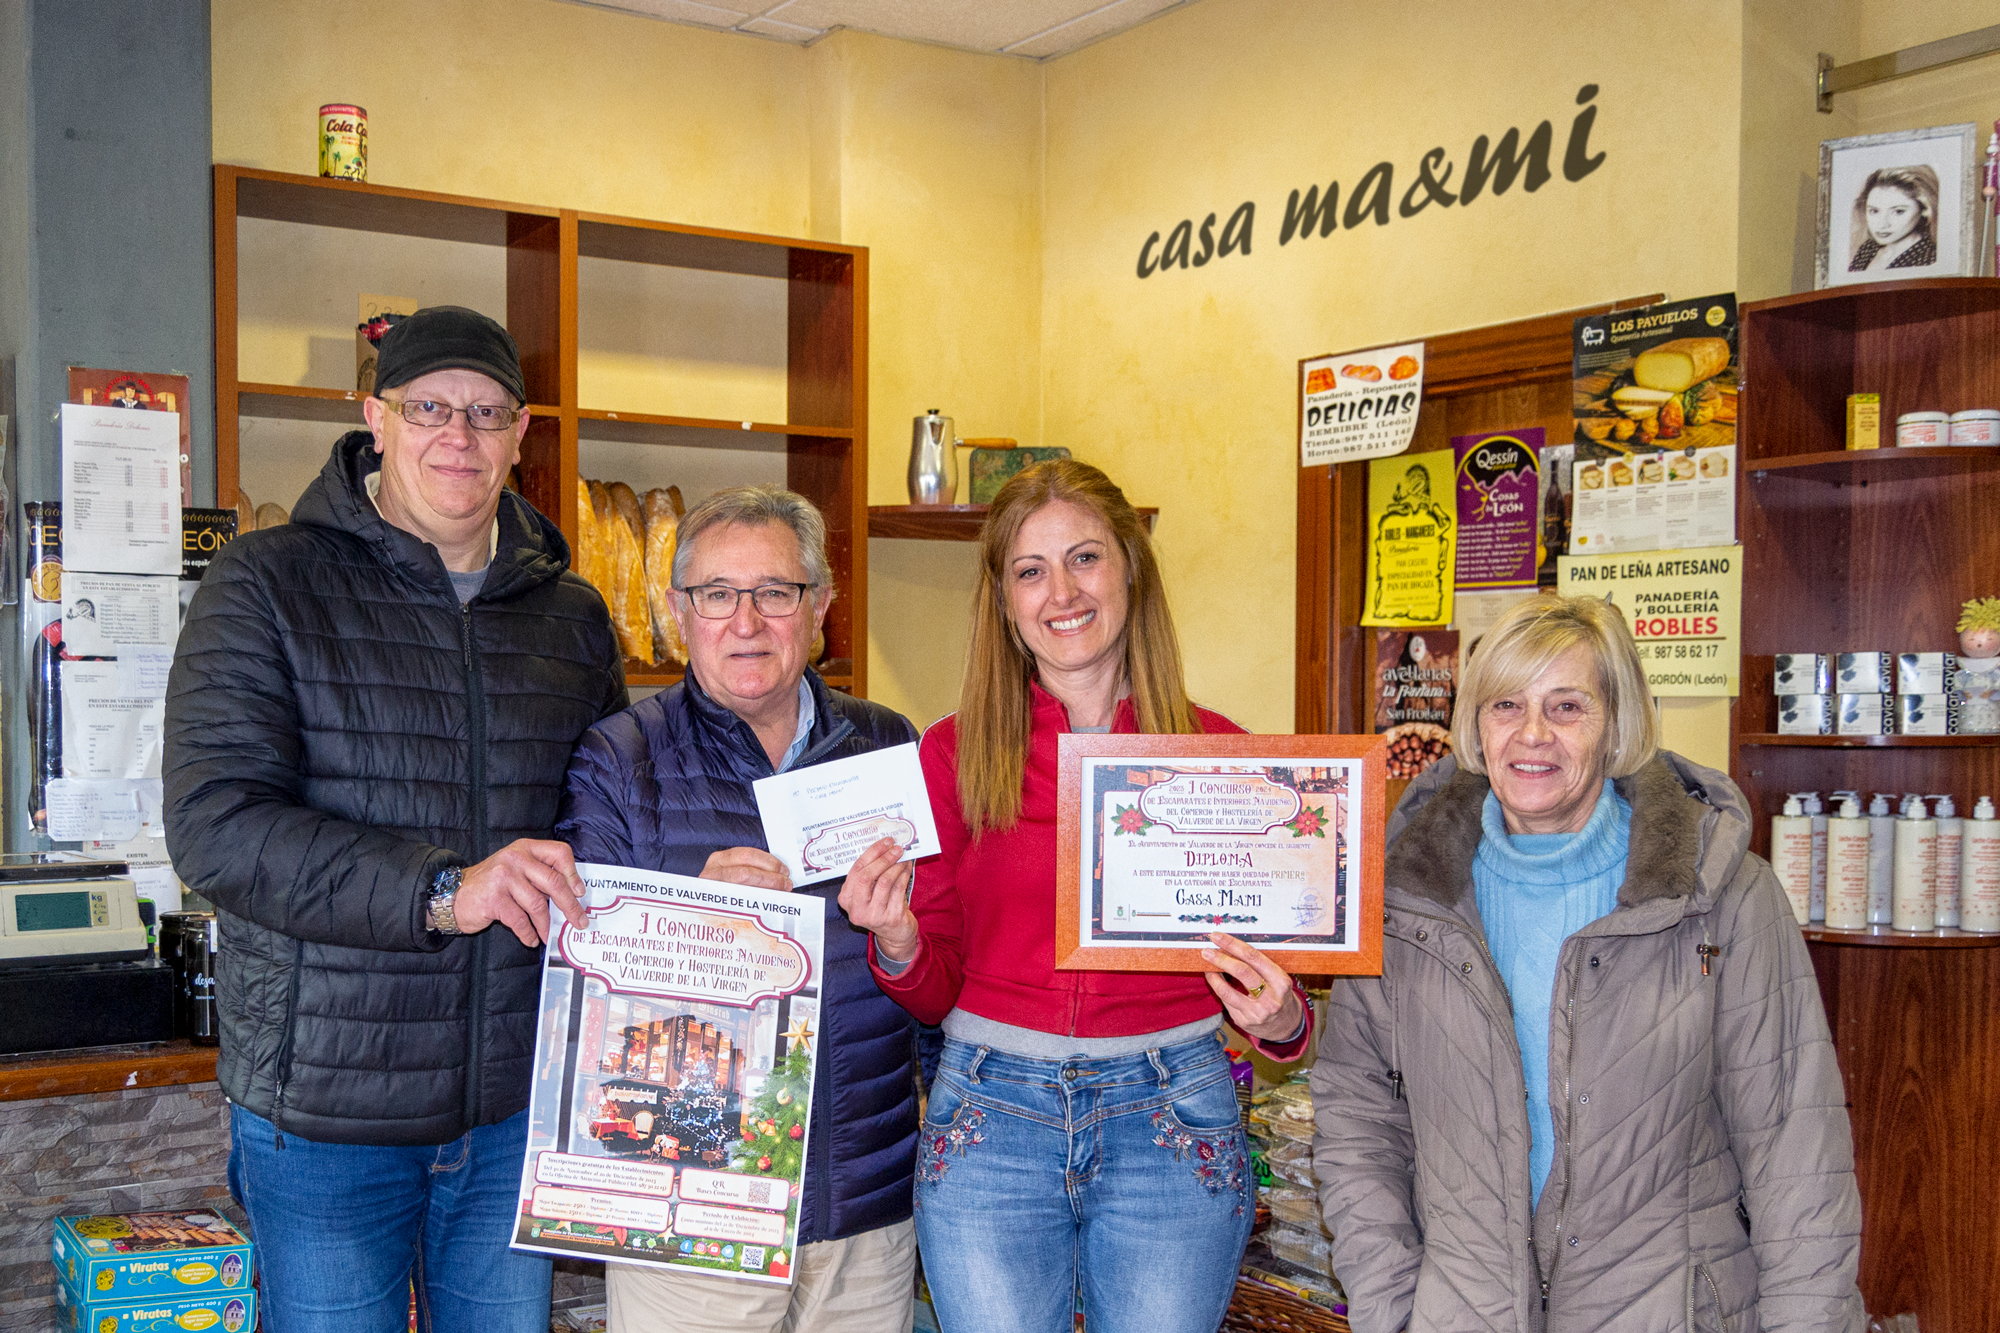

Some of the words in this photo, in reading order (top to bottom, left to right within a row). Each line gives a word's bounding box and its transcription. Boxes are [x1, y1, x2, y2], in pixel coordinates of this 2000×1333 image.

[326, 119, 353, 133] Cola
[1136, 201, 1255, 279] casa
[1610, 318, 1635, 334] LOS
[1636, 308, 1699, 329] PAYUELOS
[1610, 328, 1640, 344] Quesería
[1641, 325, 1674, 339] Artesanal
[1307, 390, 1353, 403] Panadería
[1362, 381, 1418, 396] Repostería
[1307, 391, 1417, 428] DELICIAS
[1308, 422, 1369, 437] BEMBIBRE
[1376, 416, 1412, 429] (León)
[1368, 431, 1389, 440] 511
[1367, 441, 1387, 451] 511
[183, 527, 233, 551] EÓN
[1408, 558, 1429, 566] CASERO
[1571, 566, 1597, 581] PAN
[1601, 564, 1617, 580] DE
[1621, 560, 1652, 579] LEÑA
[1656, 558, 1730, 577] ARTESANO
[1387, 582, 1399, 591] PAN
[1401, 582, 1408, 590] DE
[1410, 580, 1435, 589] HOGAZA
[1635, 590, 1720, 603] PANADERÍA
[1635, 607, 1642, 617] y
[1647, 603, 1719, 615] BOLLERÍA
[1635, 616, 1719, 637] ROBLES
[1654, 645, 1672, 659] 987
[1674, 645, 1687, 659] 58
[1689, 645, 1703, 658] 62
[1706, 644, 1719, 658] 17
[1382, 664, 1453, 683] avellanas
[1649, 670, 1692, 685] GORDÓN
[1694, 673, 1728, 687] (León)
[1943, 652, 1955, 694] caviar
[1382, 684, 1396, 697] La
[1386, 707, 1405, 720] San
[1882, 693, 1894, 736] caviar
[1948, 693, 1960, 736] caviar
[1199, 781, 1252, 795] CONCURSO
[1146, 797, 1156, 806] DE
[1156, 795, 1207, 806] ESCAPARATES
[1207, 798, 1213, 806] E
[1213, 796, 1252, 806] INTERIORES
[802, 818, 839, 833] AYUNTAMIENTO
[846, 810, 870, 821] VALVERDE
[885, 802, 904, 811] VIRGEN
[1166, 808, 1179, 817] DEL
[1180, 807, 1214, 817] COMERCIO
[1214, 808, 1221, 817] Y
[1221, 807, 1264, 817] HOSTELERÍA
[1265, 809, 1274, 817] DE
[1177, 816, 1213, 826] VALVERDE
[1215, 817, 1225, 826] DE
[1225, 817, 1236, 826] LA
[1236, 816, 1262, 826] VIRGEN
[1184, 850, 1253, 868] DIPLOMA
[1174, 878, 1183, 886] LA
[1218, 879, 1227, 887] DE
[1209, 870, 1221, 878] POR
[1221, 870, 1241, 878] HABER
[91, 894, 103, 902] kg
[583, 878, 658, 894] YUNTAMIENTO
[660, 885, 675, 898] DE
[675, 888, 728, 905] VALVERDE
[730, 896, 745, 908] DE
[746, 897, 760, 910] LA
[761, 901, 802, 917] VIRGEN
[1175, 888, 1213, 907] CASA
[1217, 889, 1262, 908] MAMI
[656, 916, 735, 945] CONCURSO
[572, 930, 587, 944] DE
[588, 929, 666, 953] ESCAPARATES
[667, 941, 674, 953] E
[676, 940, 734, 961] INTERIORES
[601, 950, 621, 964] DEL
[624, 951, 675, 970] COMERCIO
[677, 958, 686, 970] Y
[687, 961, 750, 980] HOSTELERÍA
[753, 969, 767, 983] DE
[619, 964, 675, 984] VALVERDE
[677, 973, 691, 985] DE
[692, 974, 707, 988] LA
[711, 976, 748, 994] VIRGEN
[711, 1179, 726, 1189] QR
[130, 1262, 170, 1274] Virutas
[132, 1308, 172, 1320] Virutas
